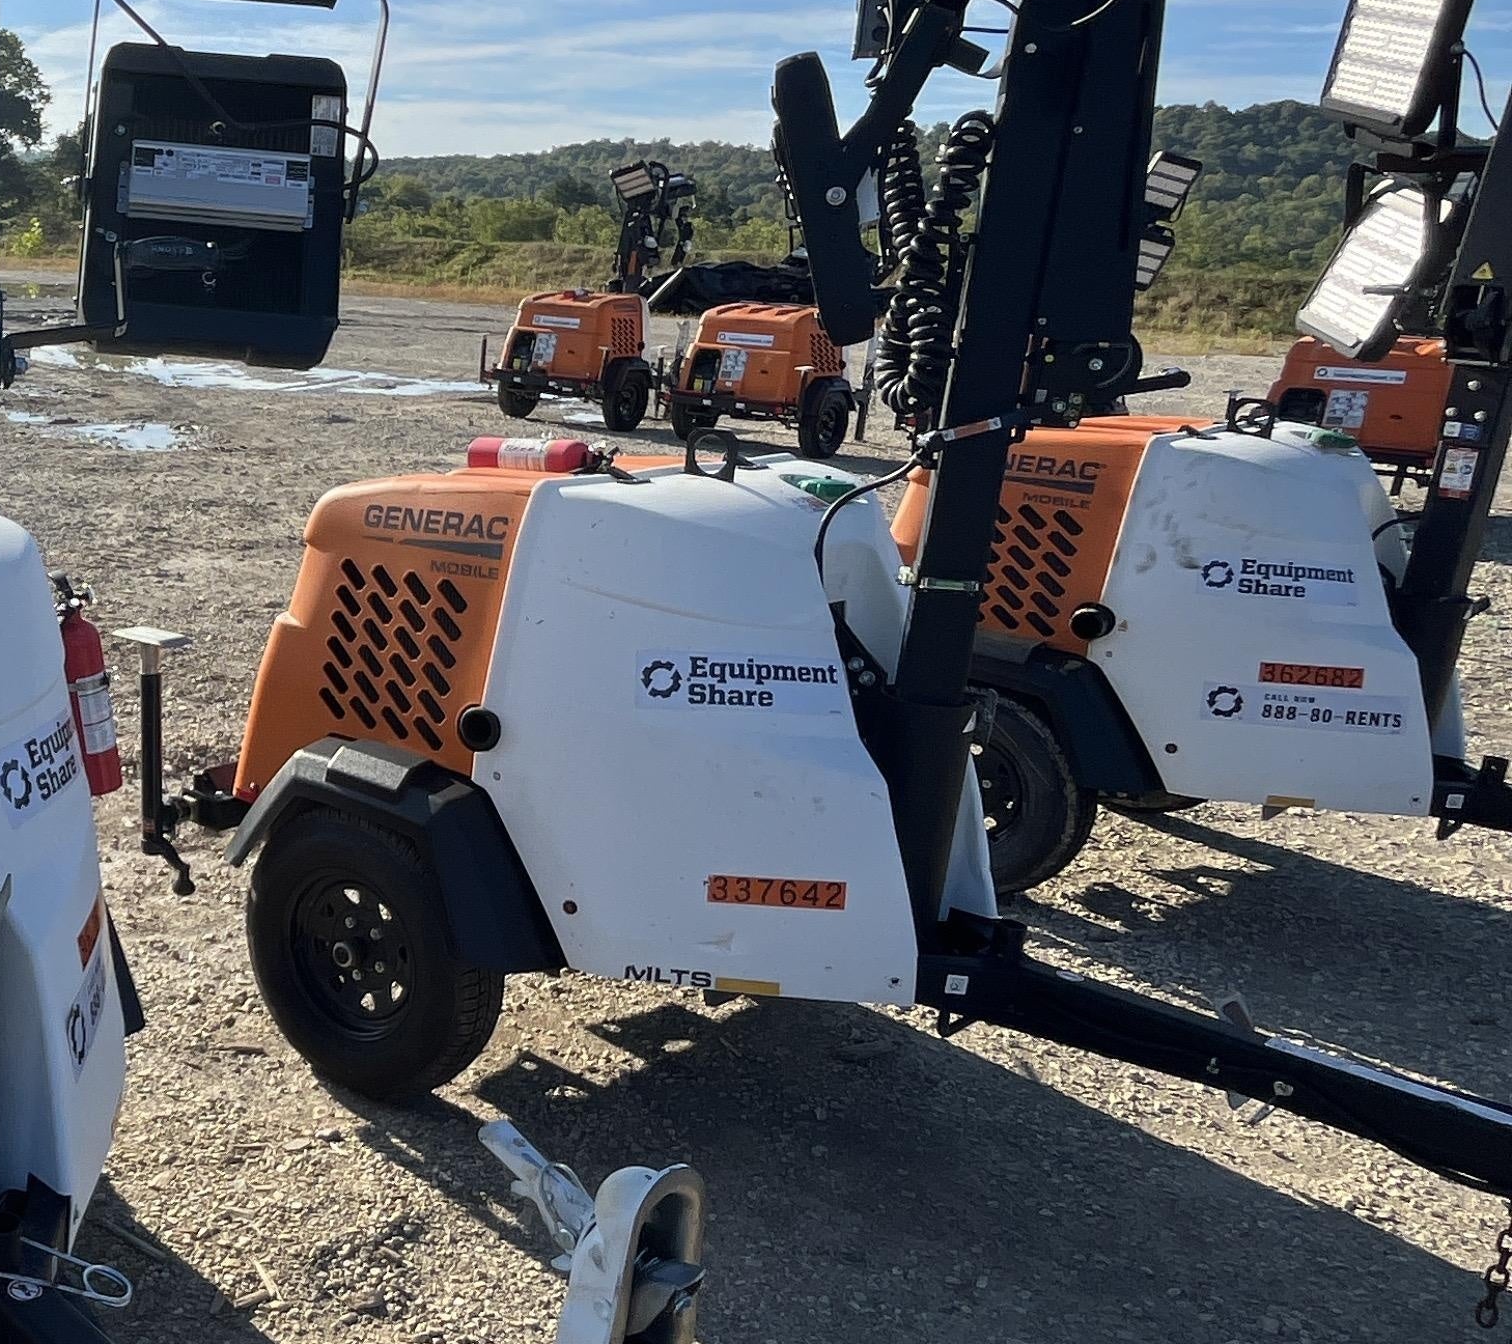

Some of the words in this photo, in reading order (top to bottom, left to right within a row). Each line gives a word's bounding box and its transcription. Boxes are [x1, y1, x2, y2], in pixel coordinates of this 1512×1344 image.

[1022, 492, 1092, 510] MOBILE
[364, 504, 509, 541] GENERAC
[429, 559, 500, 581] MOBILE
[1239, 558, 1355, 584] Equipment
[1237, 578, 1306, 598] Share
[688, 656, 838, 685] Equipment
[1262, 662, 1362, 689] 362682
[687, 683, 774, 707] Share
[1264, 692, 1289, 703] CALL
[1261, 703, 1402, 729] 888-80-RENTS
[35, 754, 78, 802] Share
[711, 875, 844, 909] 337642
[624, 964, 712, 988] MLTS
